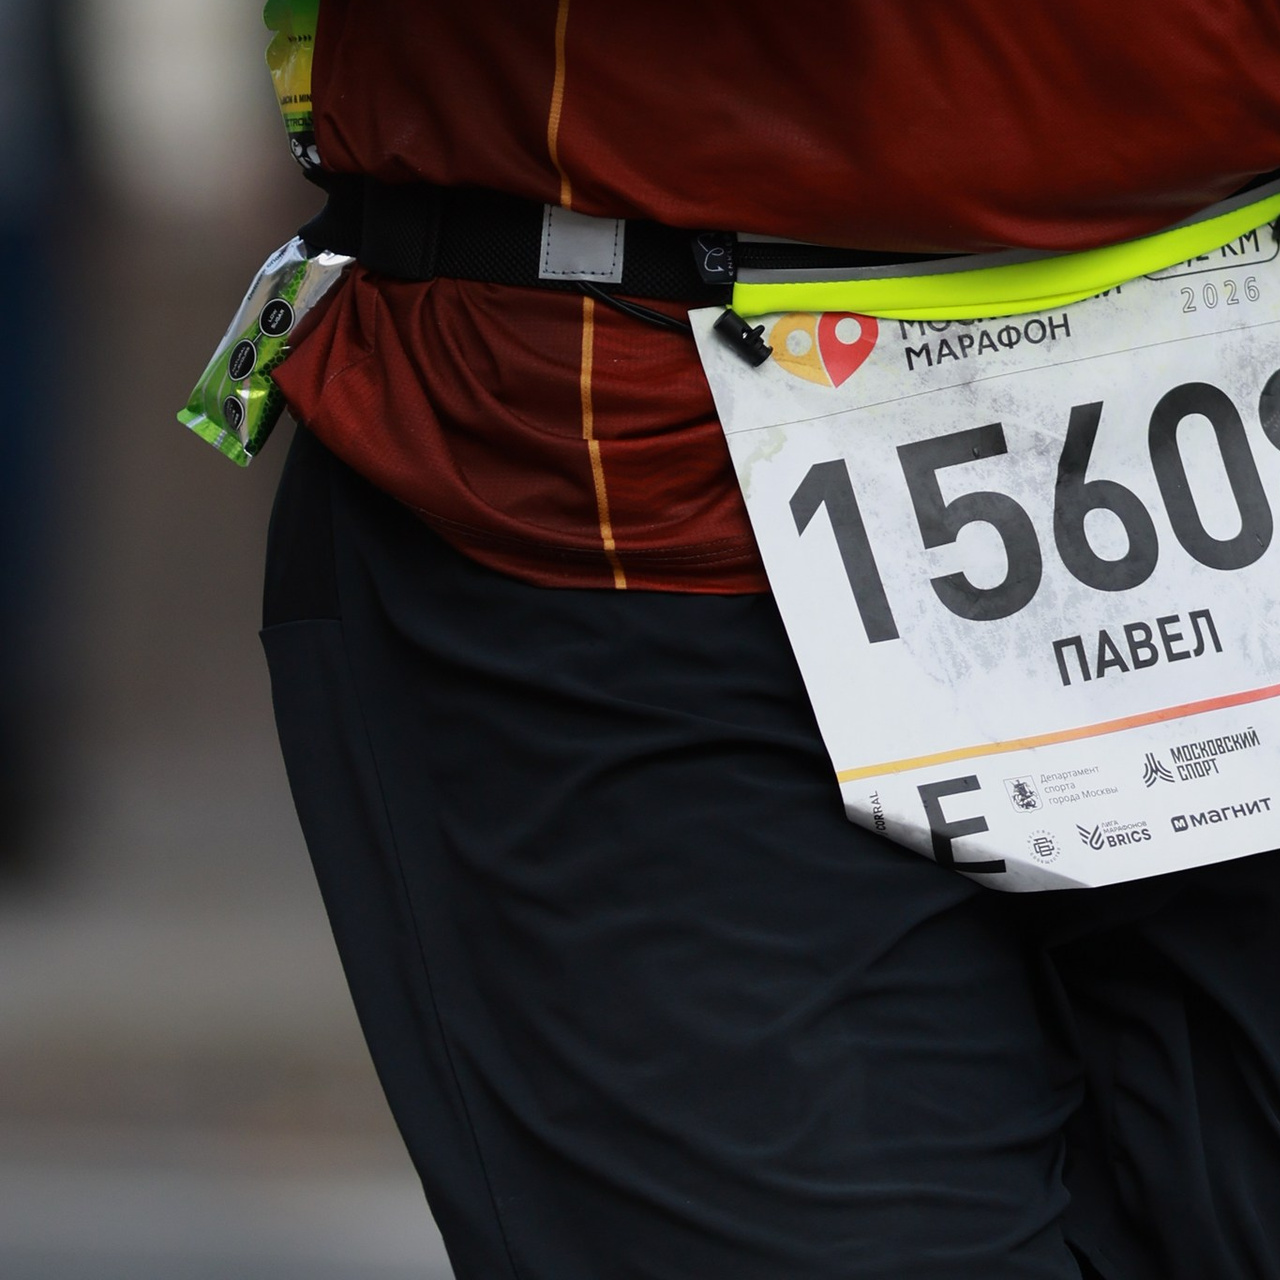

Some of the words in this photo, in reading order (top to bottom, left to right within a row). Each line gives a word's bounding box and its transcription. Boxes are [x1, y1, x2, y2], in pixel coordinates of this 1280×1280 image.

[1180, 276, 1261, 314] 2026
[904, 312, 1072, 371] МАРАФОН
[1053, 607, 1223, 688] ПАВЕЛ
[1169, 726, 1261, 765] МОСКОВСКИЙ
[1040, 765, 1100, 784] Департамент
[1175, 758, 1220, 783] СПОРТ
[1044, 782, 1076, 794] спорта
[1048, 793, 1081, 806] города
[1081, 786, 1119, 799] Москвы
[869, 790, 886, 832] CORRAL
[916, 774, 1007, 874] E
[1103, 820, 1148, 835] МАРАФОНОВ
[1106, 828, 1152, 848] BRICS
